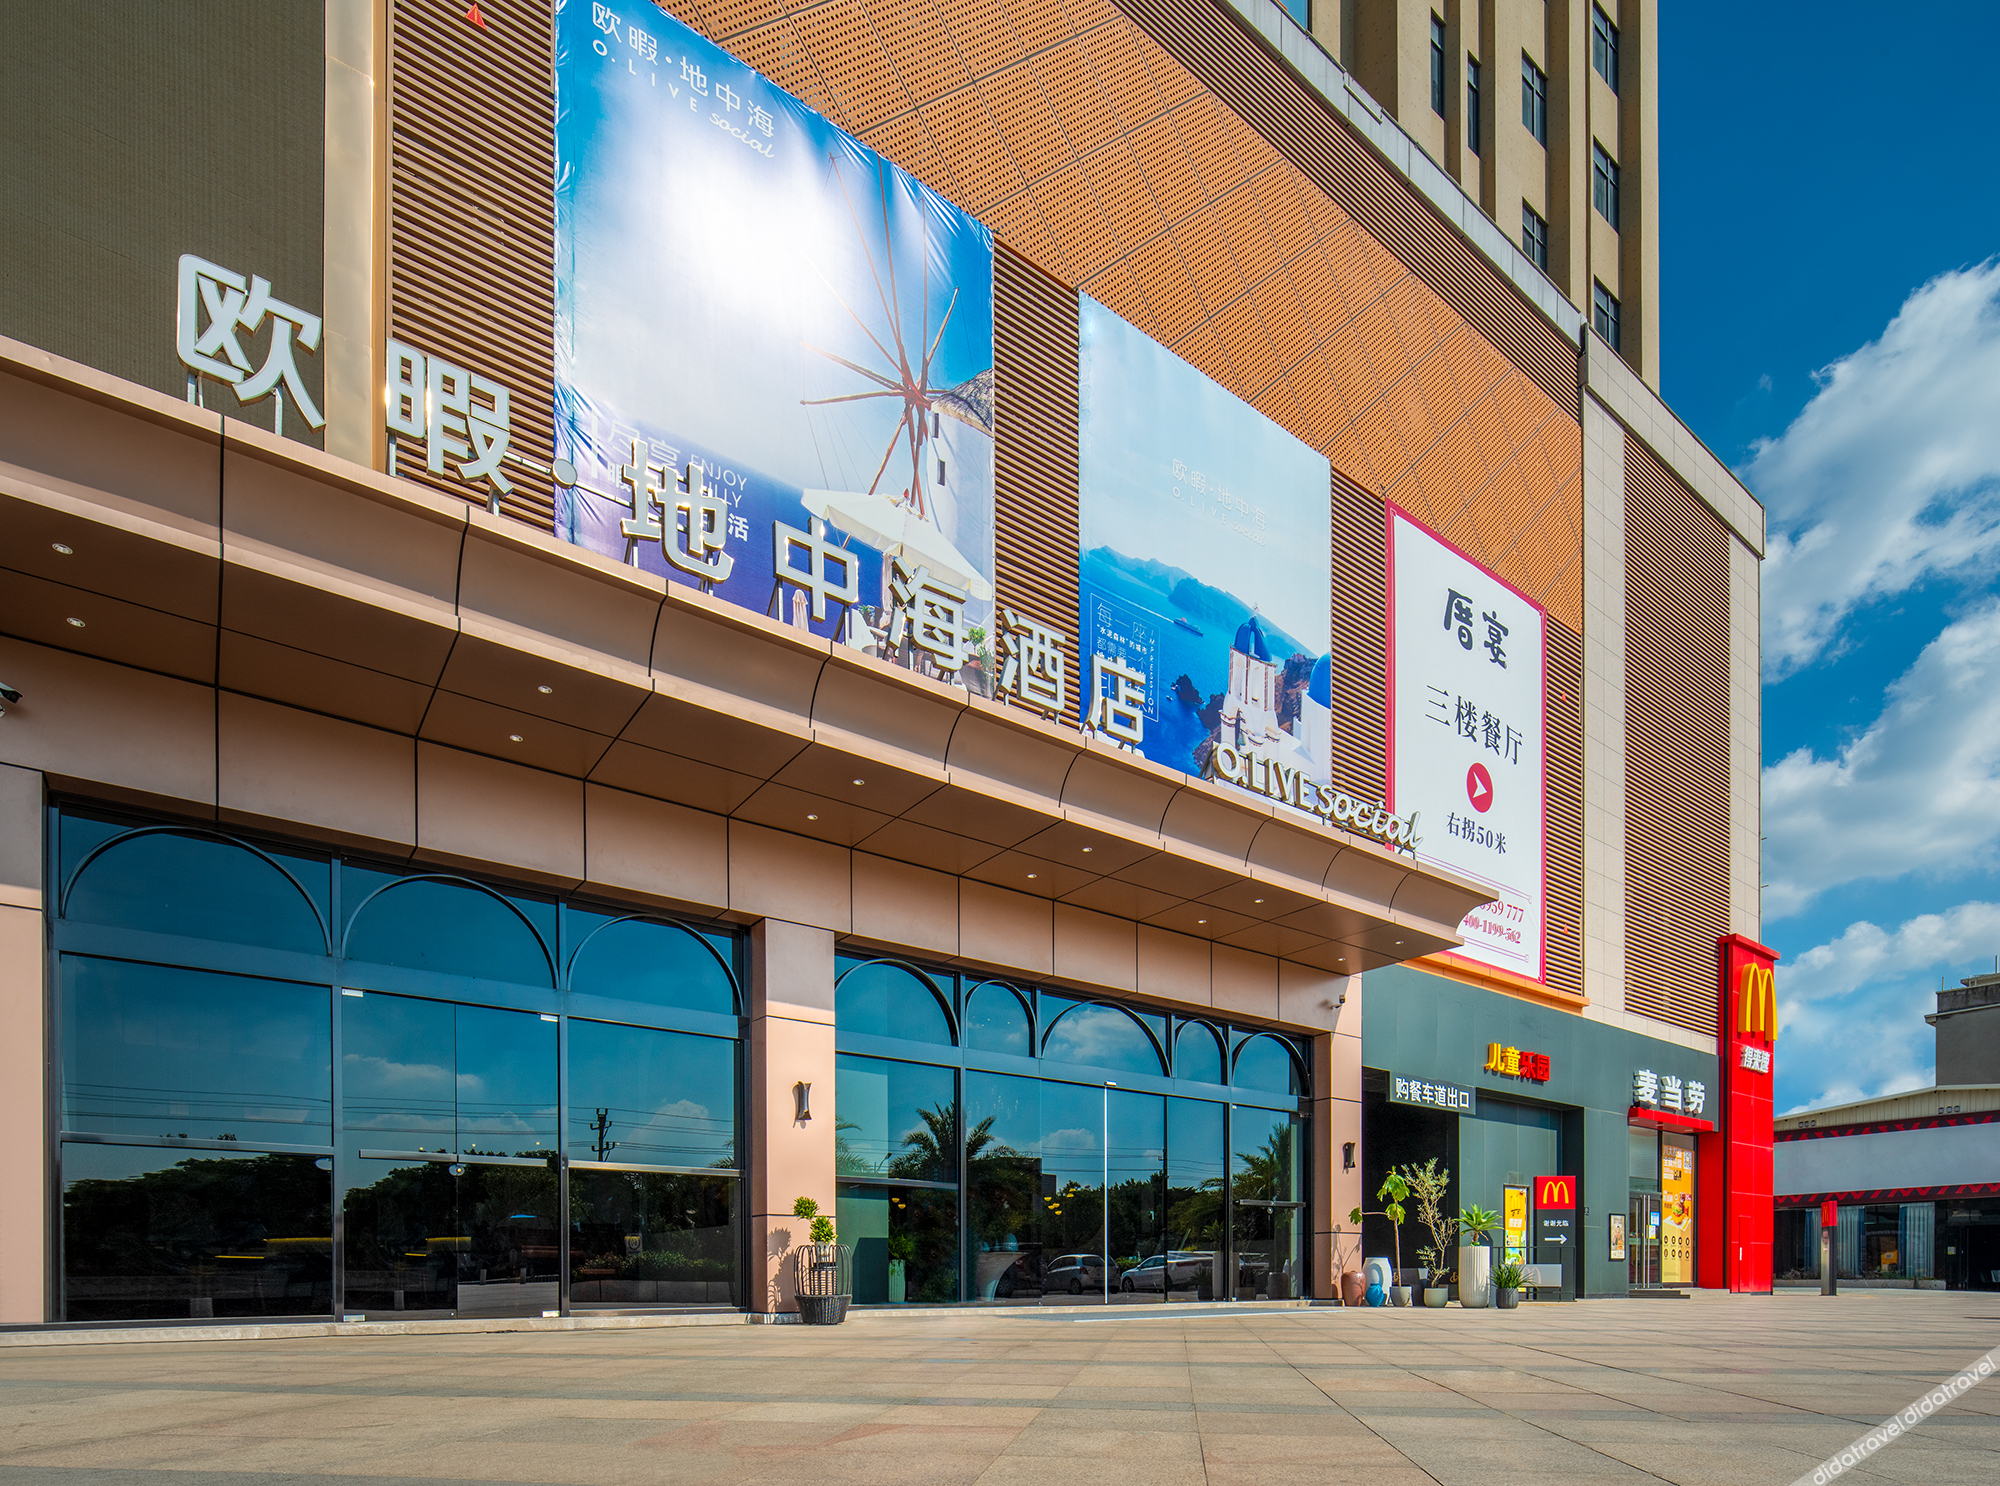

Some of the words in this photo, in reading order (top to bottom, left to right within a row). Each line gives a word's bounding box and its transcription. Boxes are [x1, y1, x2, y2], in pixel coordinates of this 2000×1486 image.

[708, 112, 775, 158] social
[1231, 521, 1266, 546] social
[1425, 684, 1523, 766] 三楼餐厅
[1315, 784, 1424, 848] social
[1446, 811, 1508, 855] 右拐50米
[1485, 1042, 1551, 1082] 儿童乐园
[1396, 1077, 1470, 1109] 购餐车道出口
[1634, 1069, 1706, 1115] 麦当劳
